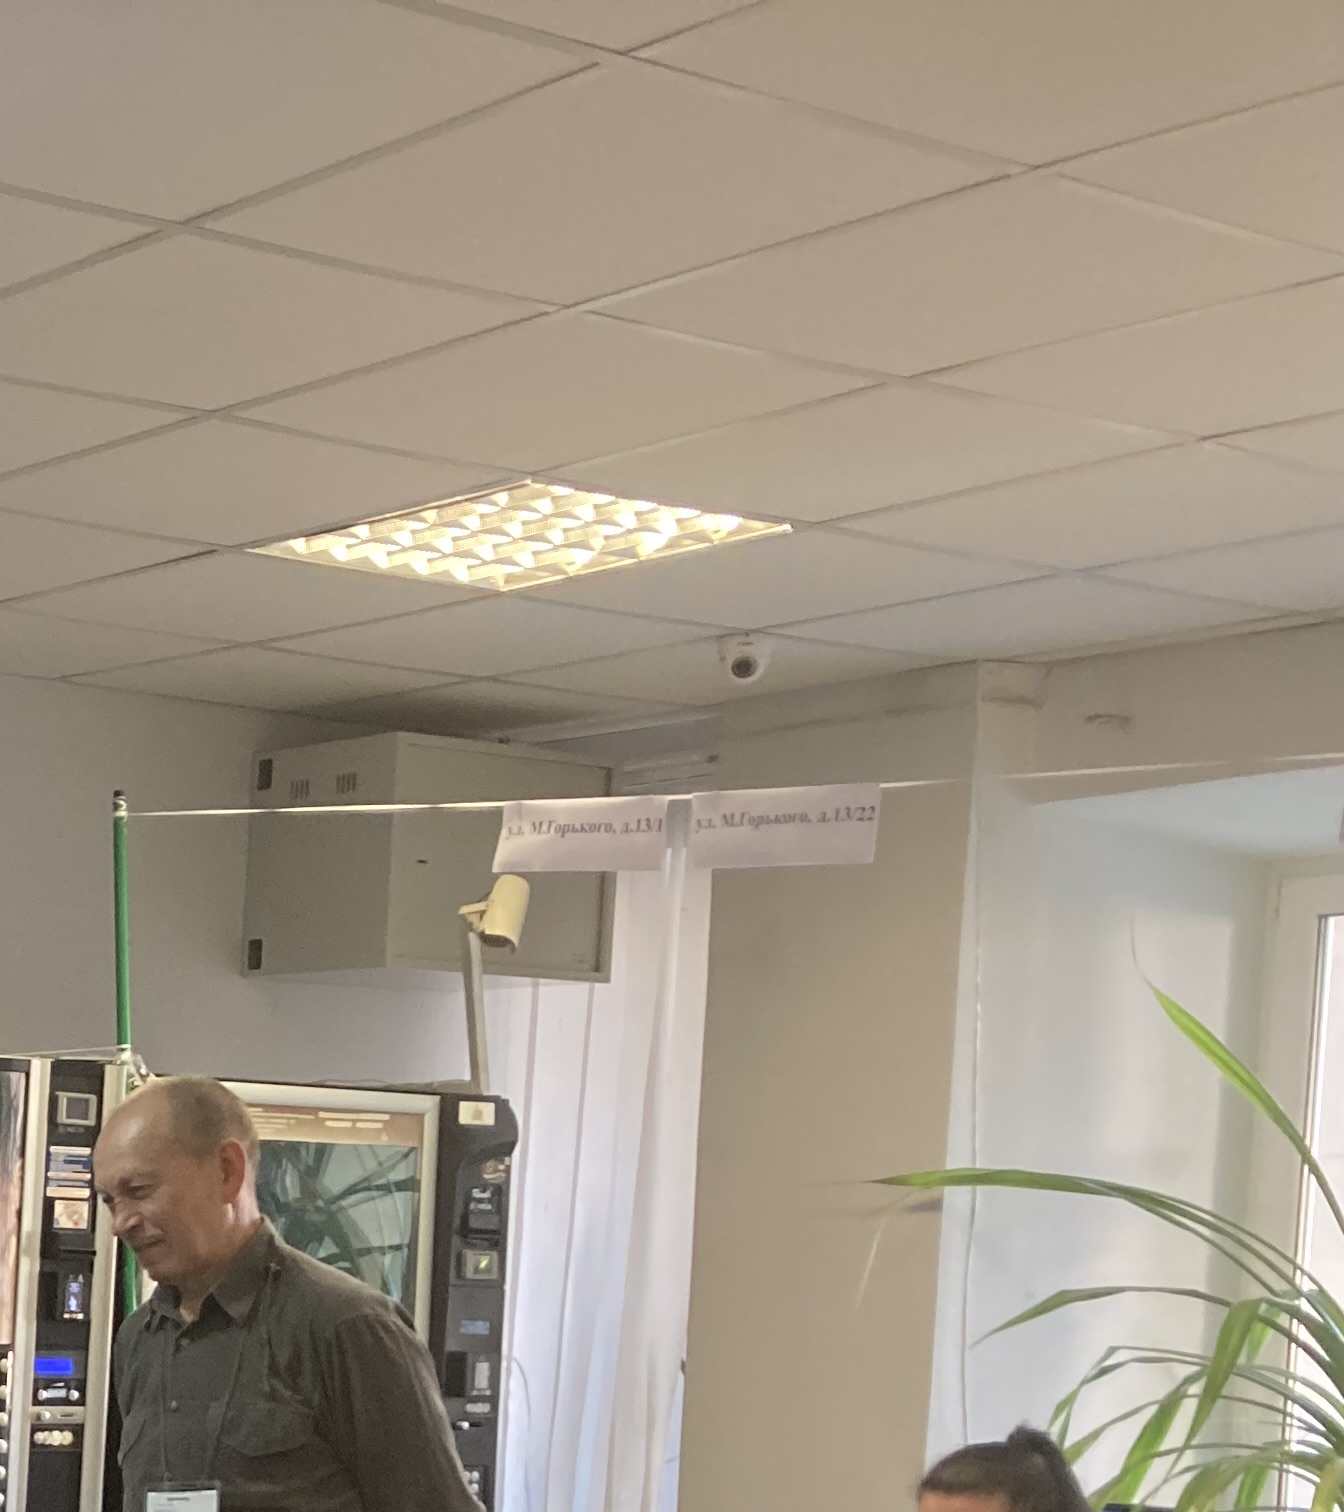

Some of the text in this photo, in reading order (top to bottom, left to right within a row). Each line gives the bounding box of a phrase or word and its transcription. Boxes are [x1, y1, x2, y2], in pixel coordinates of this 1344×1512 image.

[695, 818, 717, 833] ул.
[816, 805, 877, 824] д.13/22
[505, 825, 525, 840] ул.
